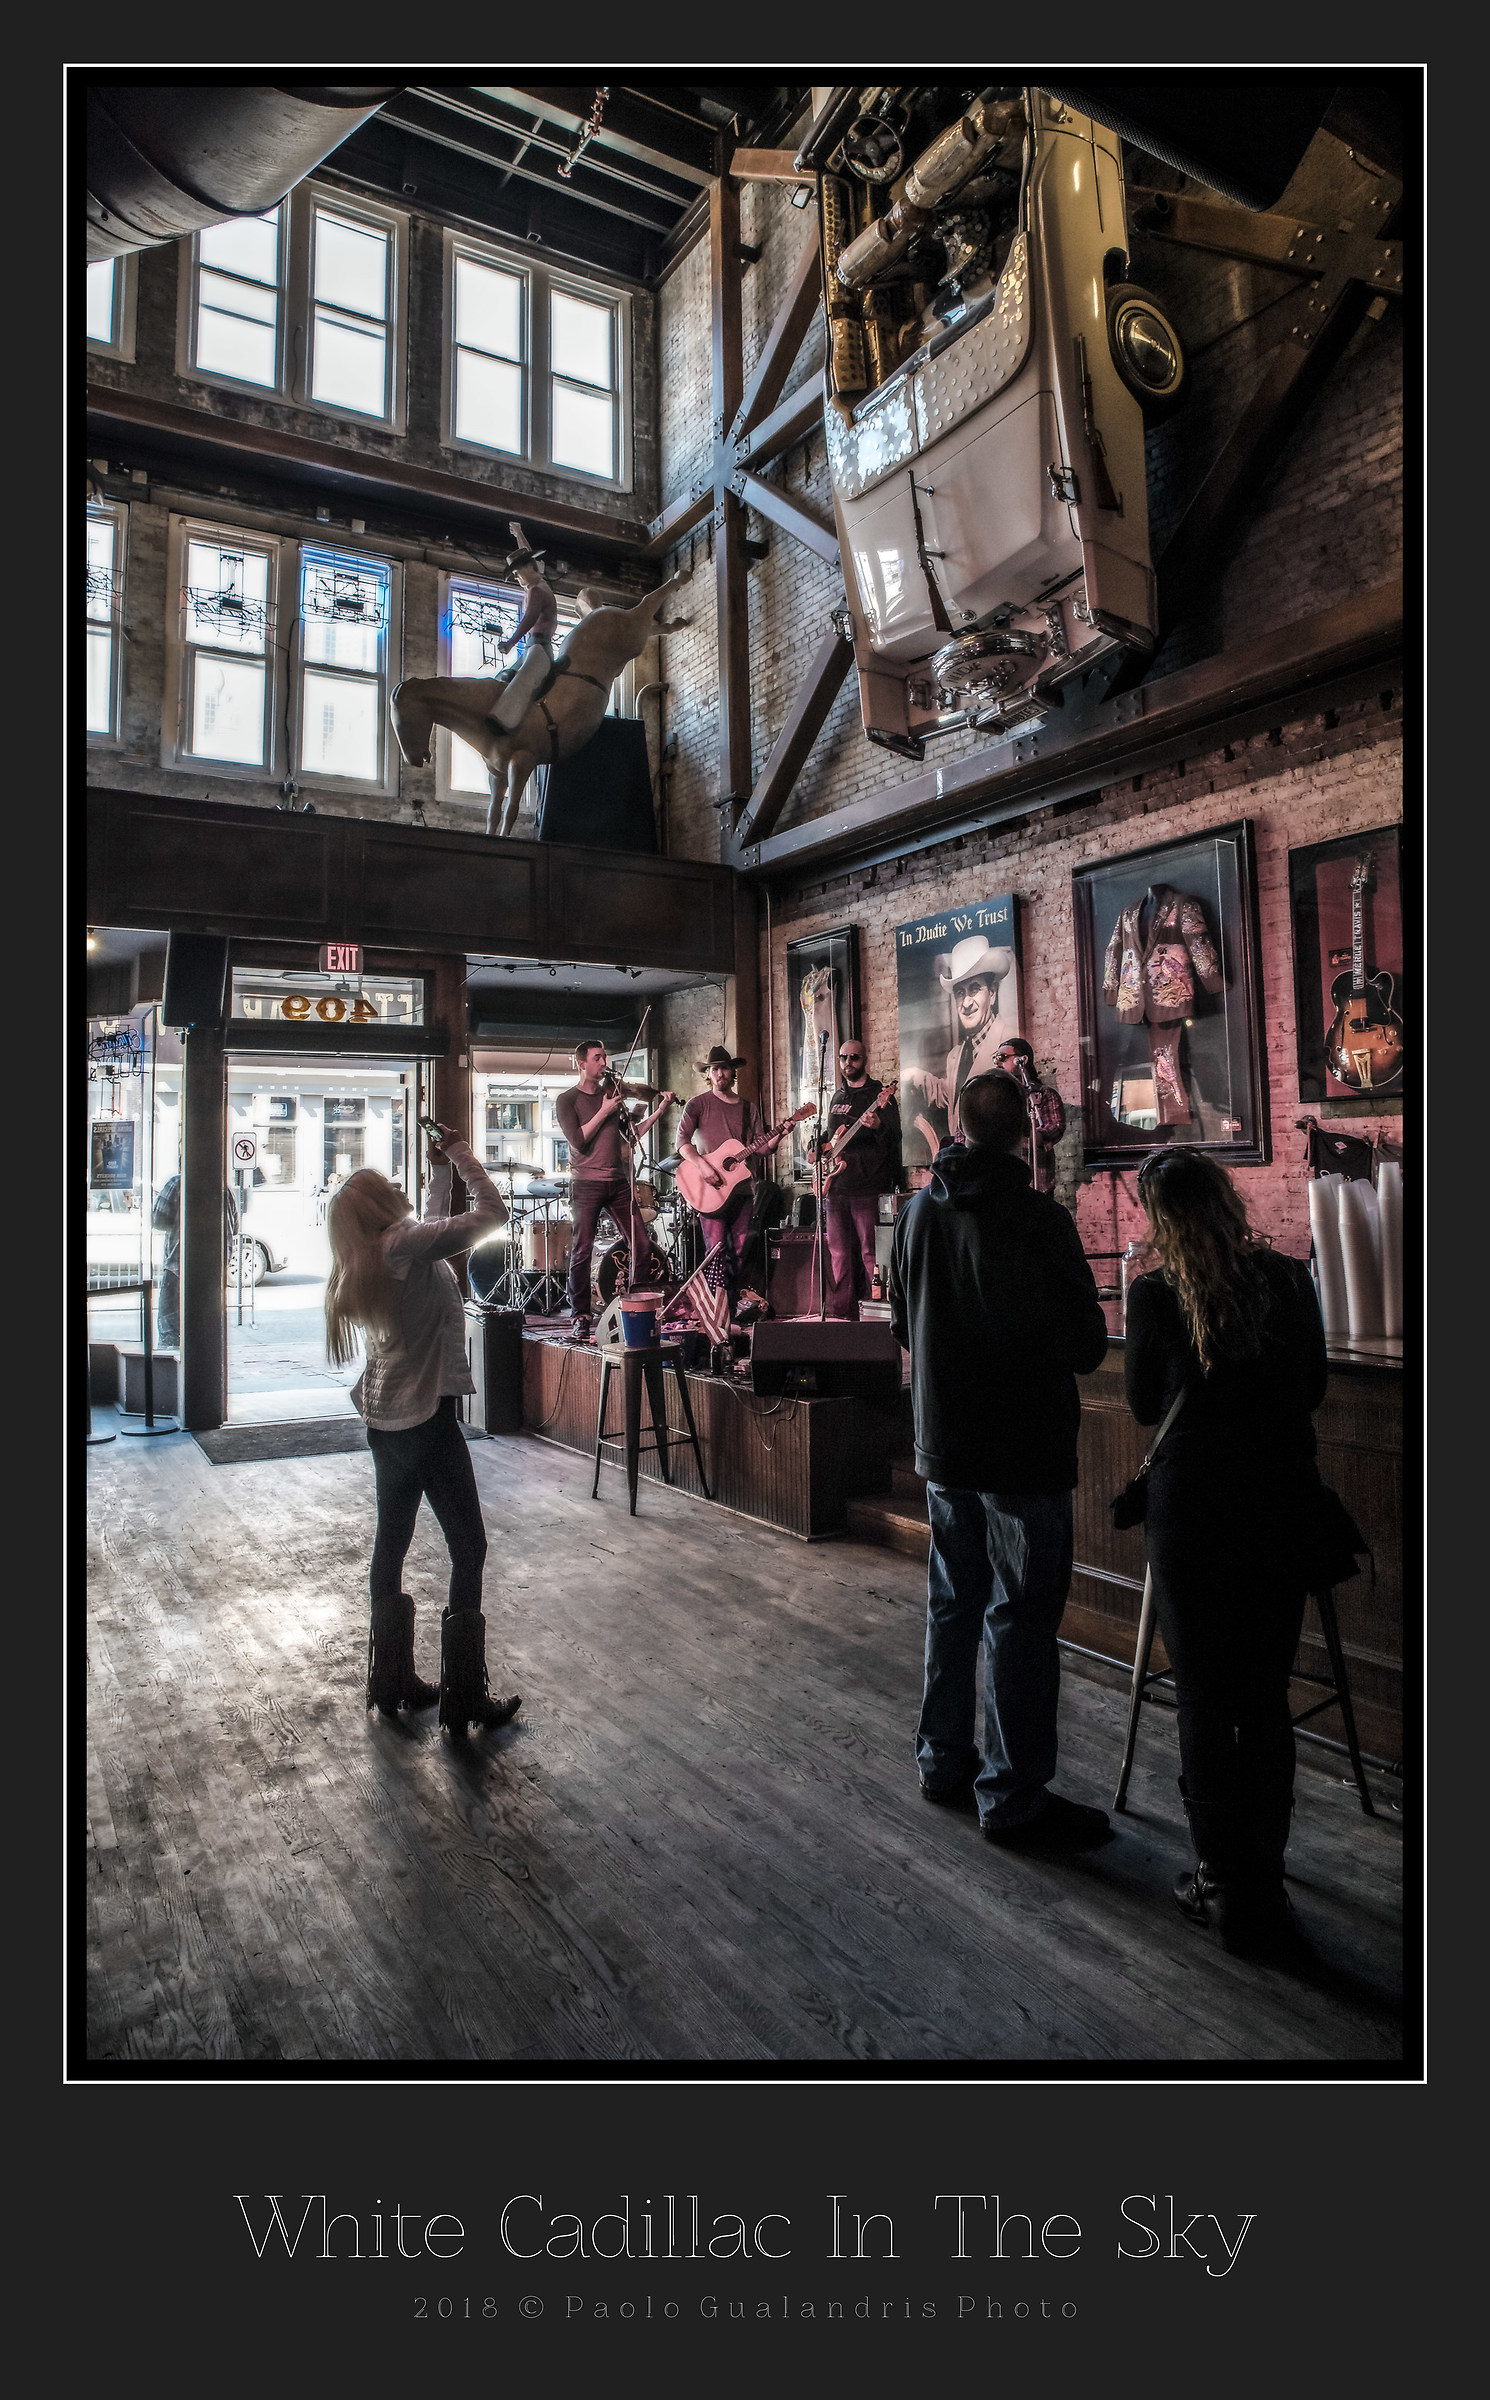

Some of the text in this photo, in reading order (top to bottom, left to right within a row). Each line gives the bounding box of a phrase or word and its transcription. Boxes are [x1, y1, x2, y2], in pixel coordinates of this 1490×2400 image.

[899, 906, 1009, 947] In Nudie We Trust
[327, 945, 358, 971] EXIT
